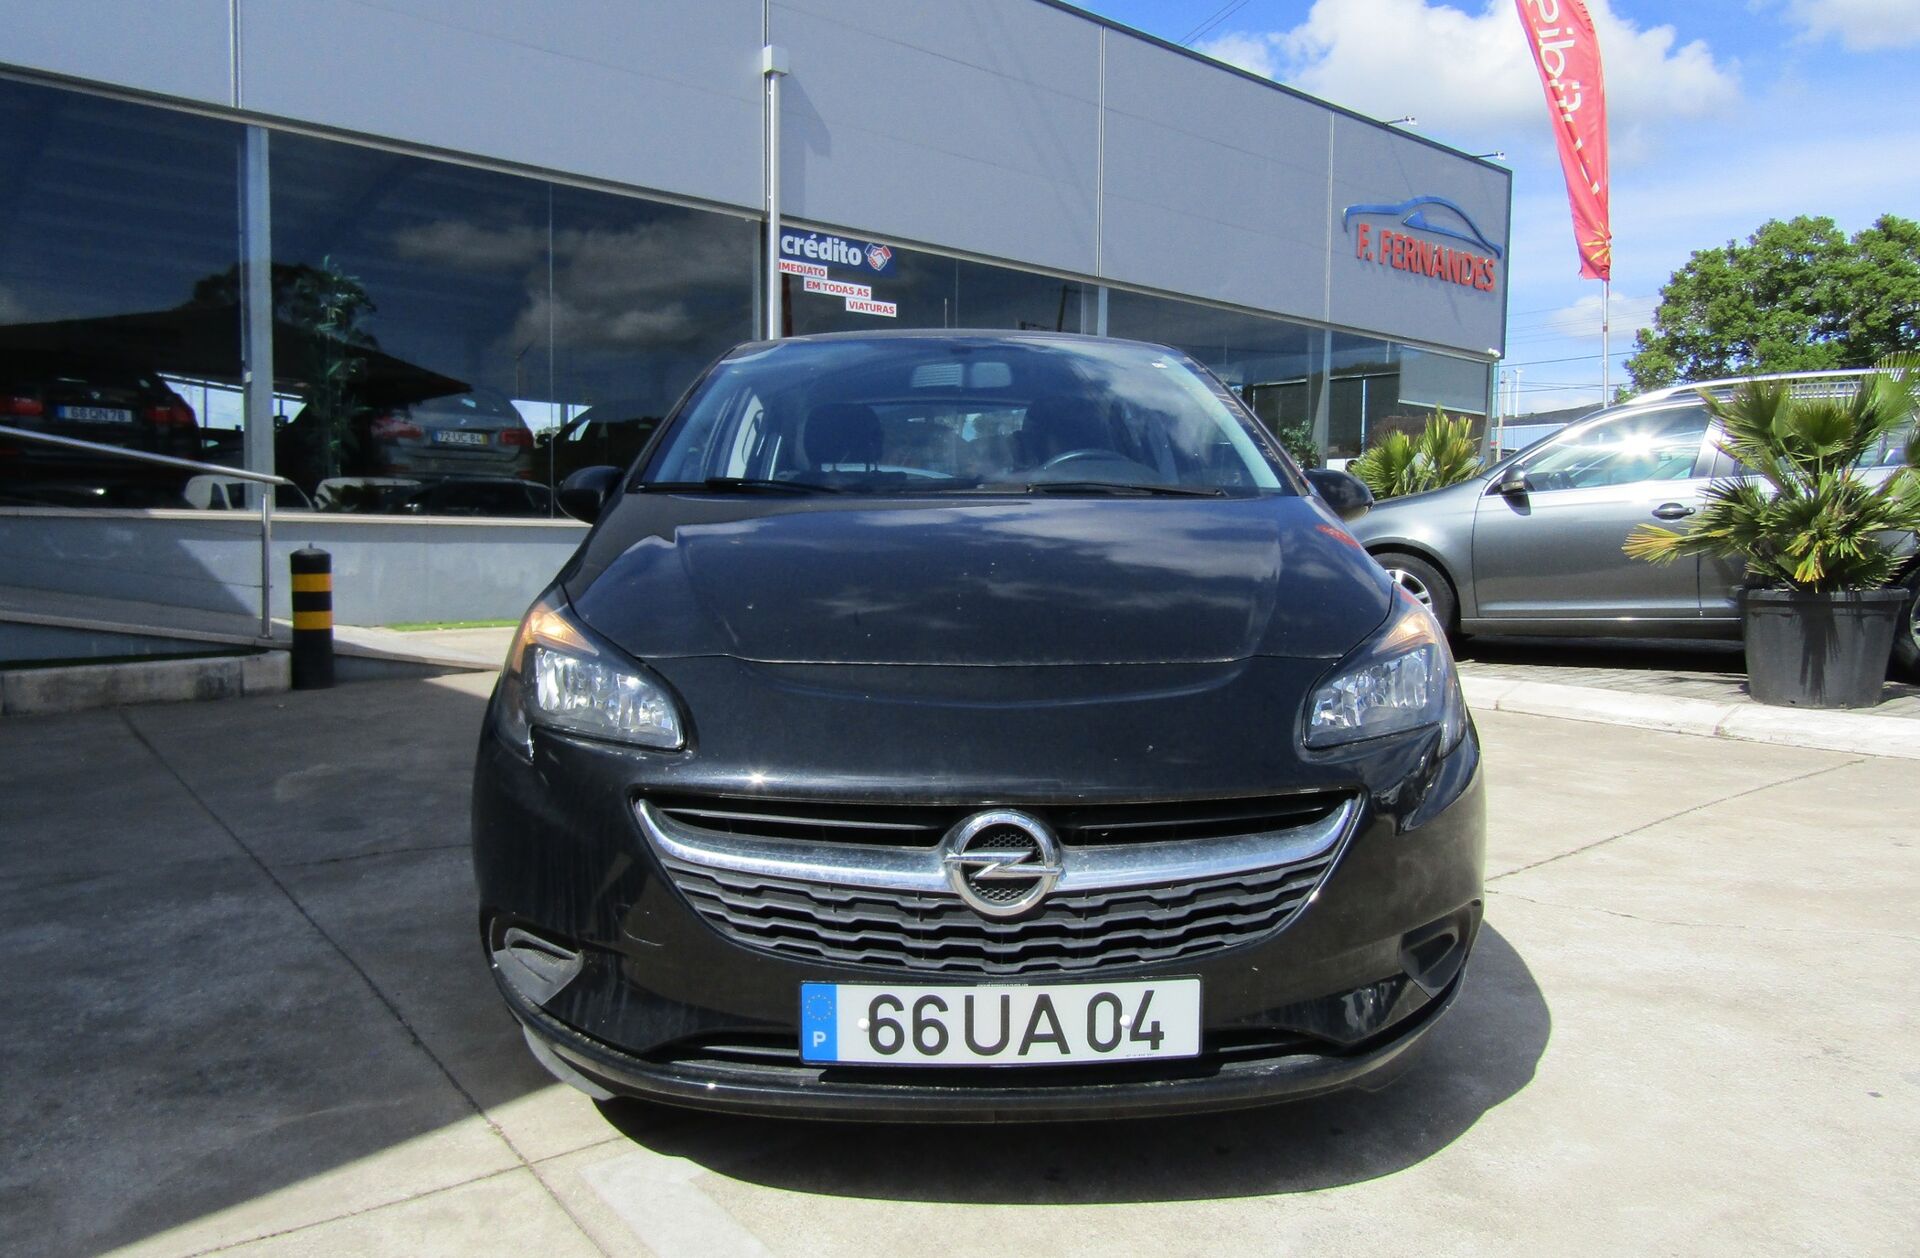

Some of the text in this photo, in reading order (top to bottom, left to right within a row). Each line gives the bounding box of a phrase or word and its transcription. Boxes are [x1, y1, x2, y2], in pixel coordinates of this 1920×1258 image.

[781, 234, 862, 266] crédito
[1357, 223, 1496, 292] F. FERNANDES
[778, 261, 826, 277] IMEDIATO
[806, 280, 869, 297] EM TODAS AS
[849, 301, 895, 314] VIATURAS
[813, 1031, 826, 1048] P
